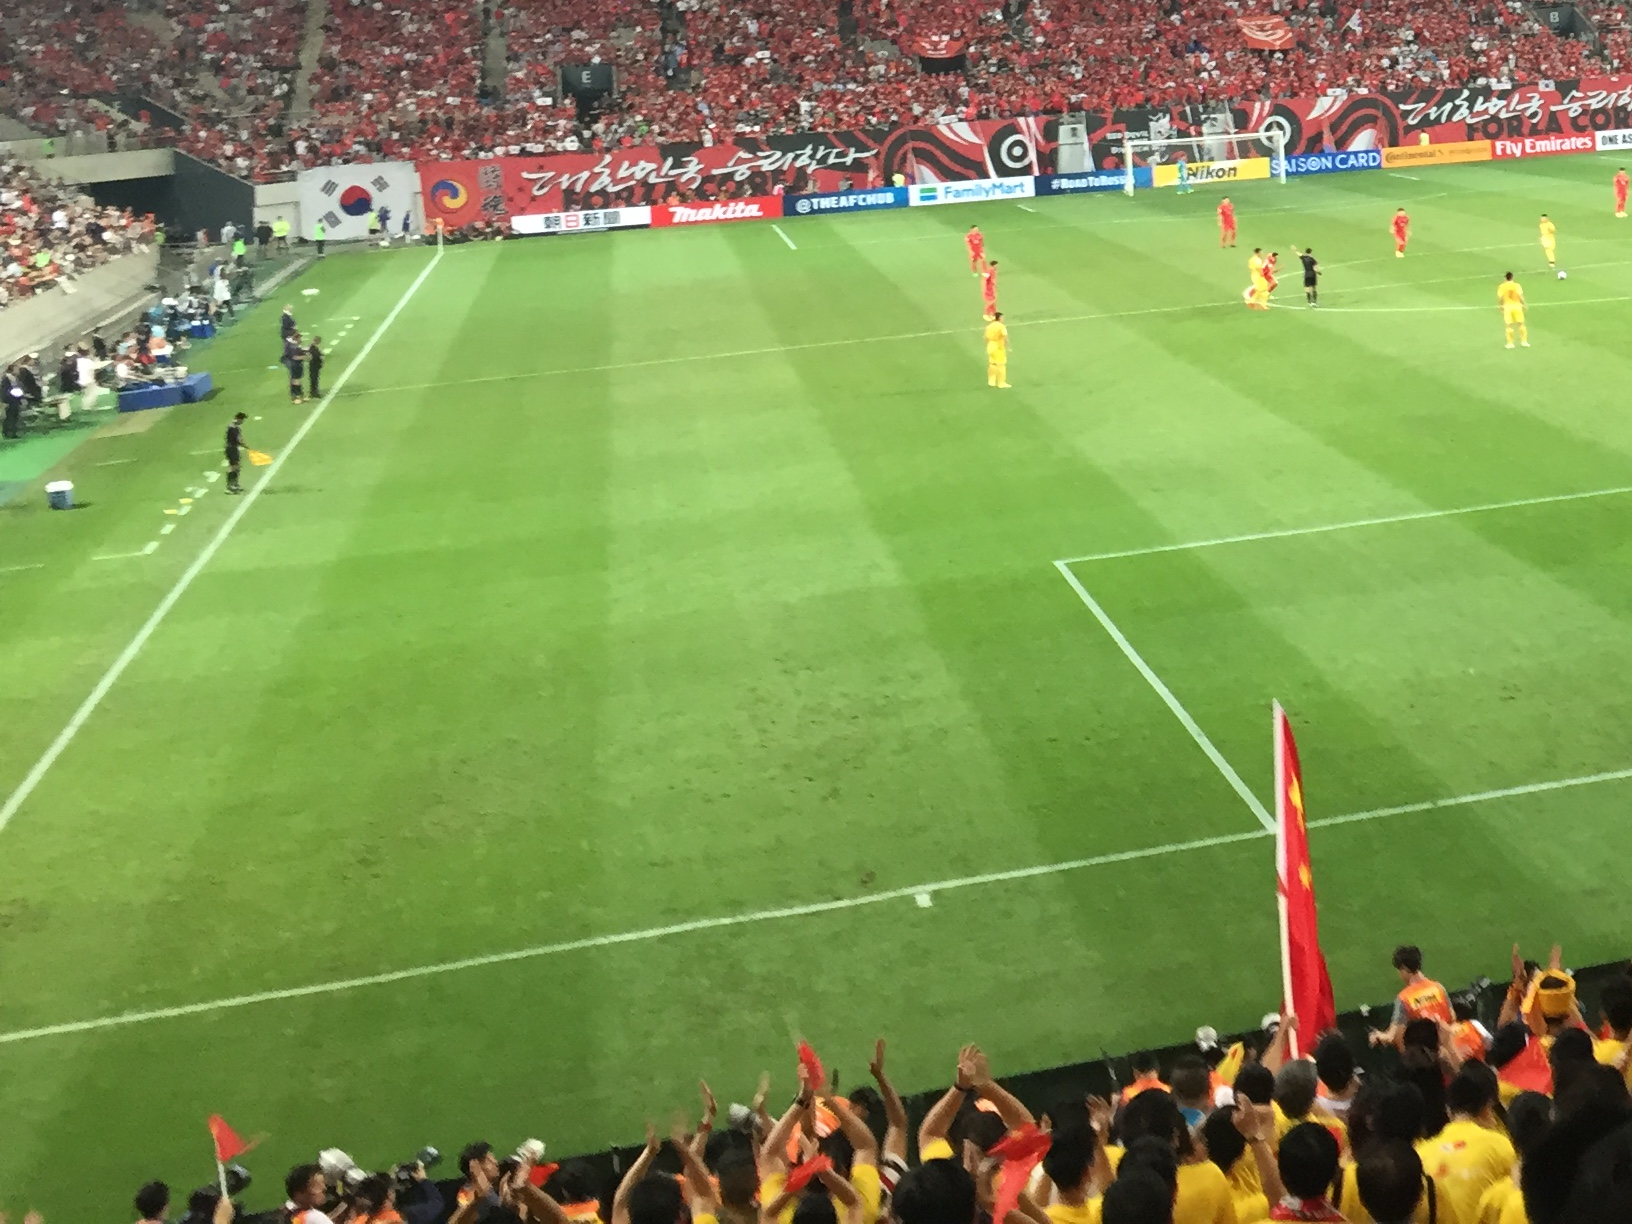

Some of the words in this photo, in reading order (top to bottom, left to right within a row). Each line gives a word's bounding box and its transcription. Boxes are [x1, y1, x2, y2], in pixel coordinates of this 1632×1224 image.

[581, 71, 592, 83] E
[1494, 140, 1523, 157] Fly
[1524, 136, 1593, 153] Emirates
[1601, 134, 1619, 146] ONE
[1271, 155, 1333, 174] SAISON
[1335, 151, 1380, 169] CARD
[1187, 164, 1237, 180] Nikon
[944, 182, 1025, 199] FamilyMart
